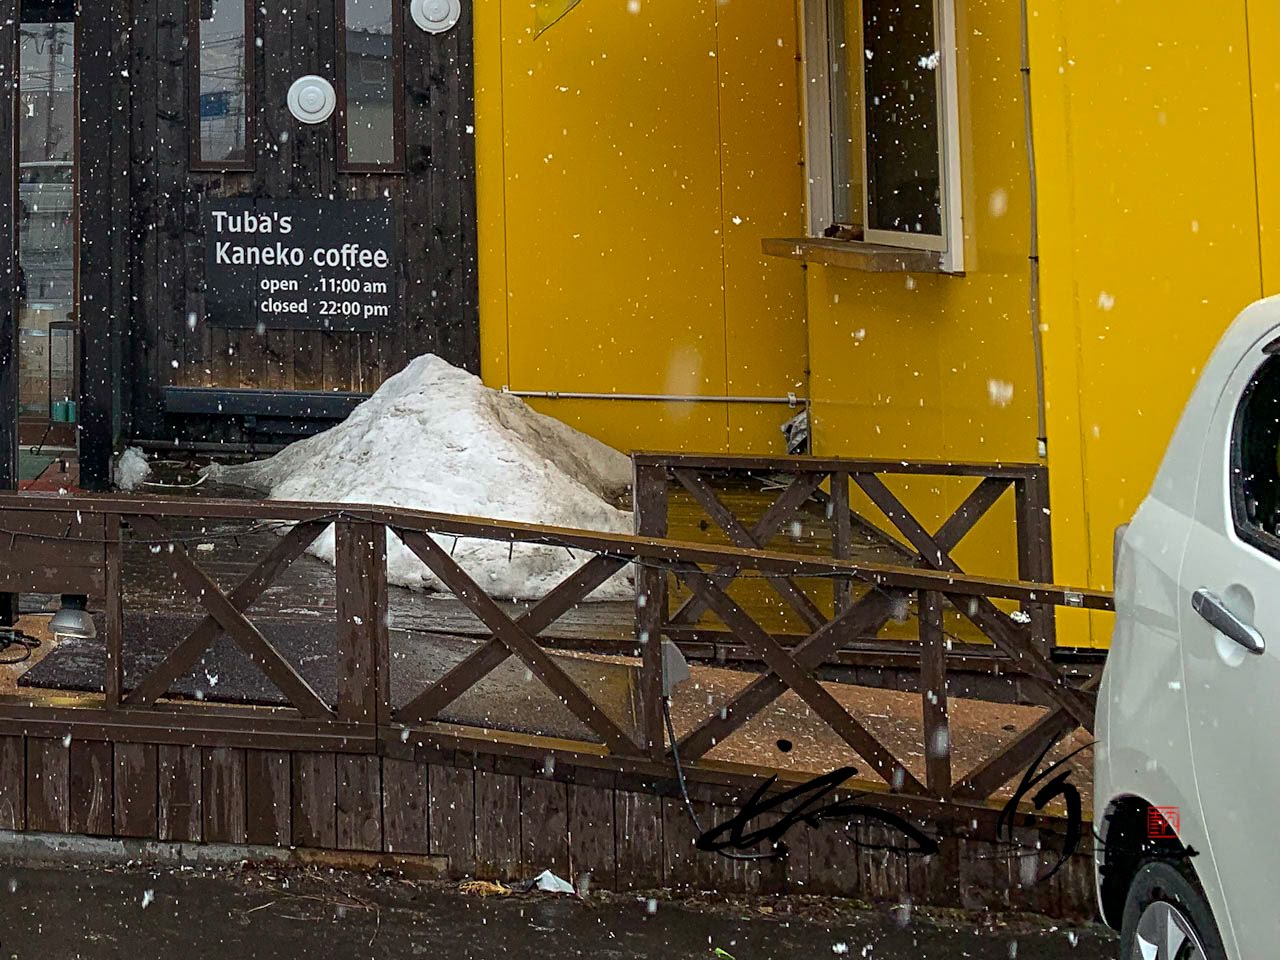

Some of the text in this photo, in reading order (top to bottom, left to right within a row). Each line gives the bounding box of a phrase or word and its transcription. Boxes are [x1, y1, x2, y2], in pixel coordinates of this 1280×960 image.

[212, 211, 292, 233] Tuba's
[216, 242, 388, 268] Kaneko coffee
[260, 279, 299, 293] open
[363, 282, 387, 293] am
[260, 298, 388, 318] closed 22:00 pm
